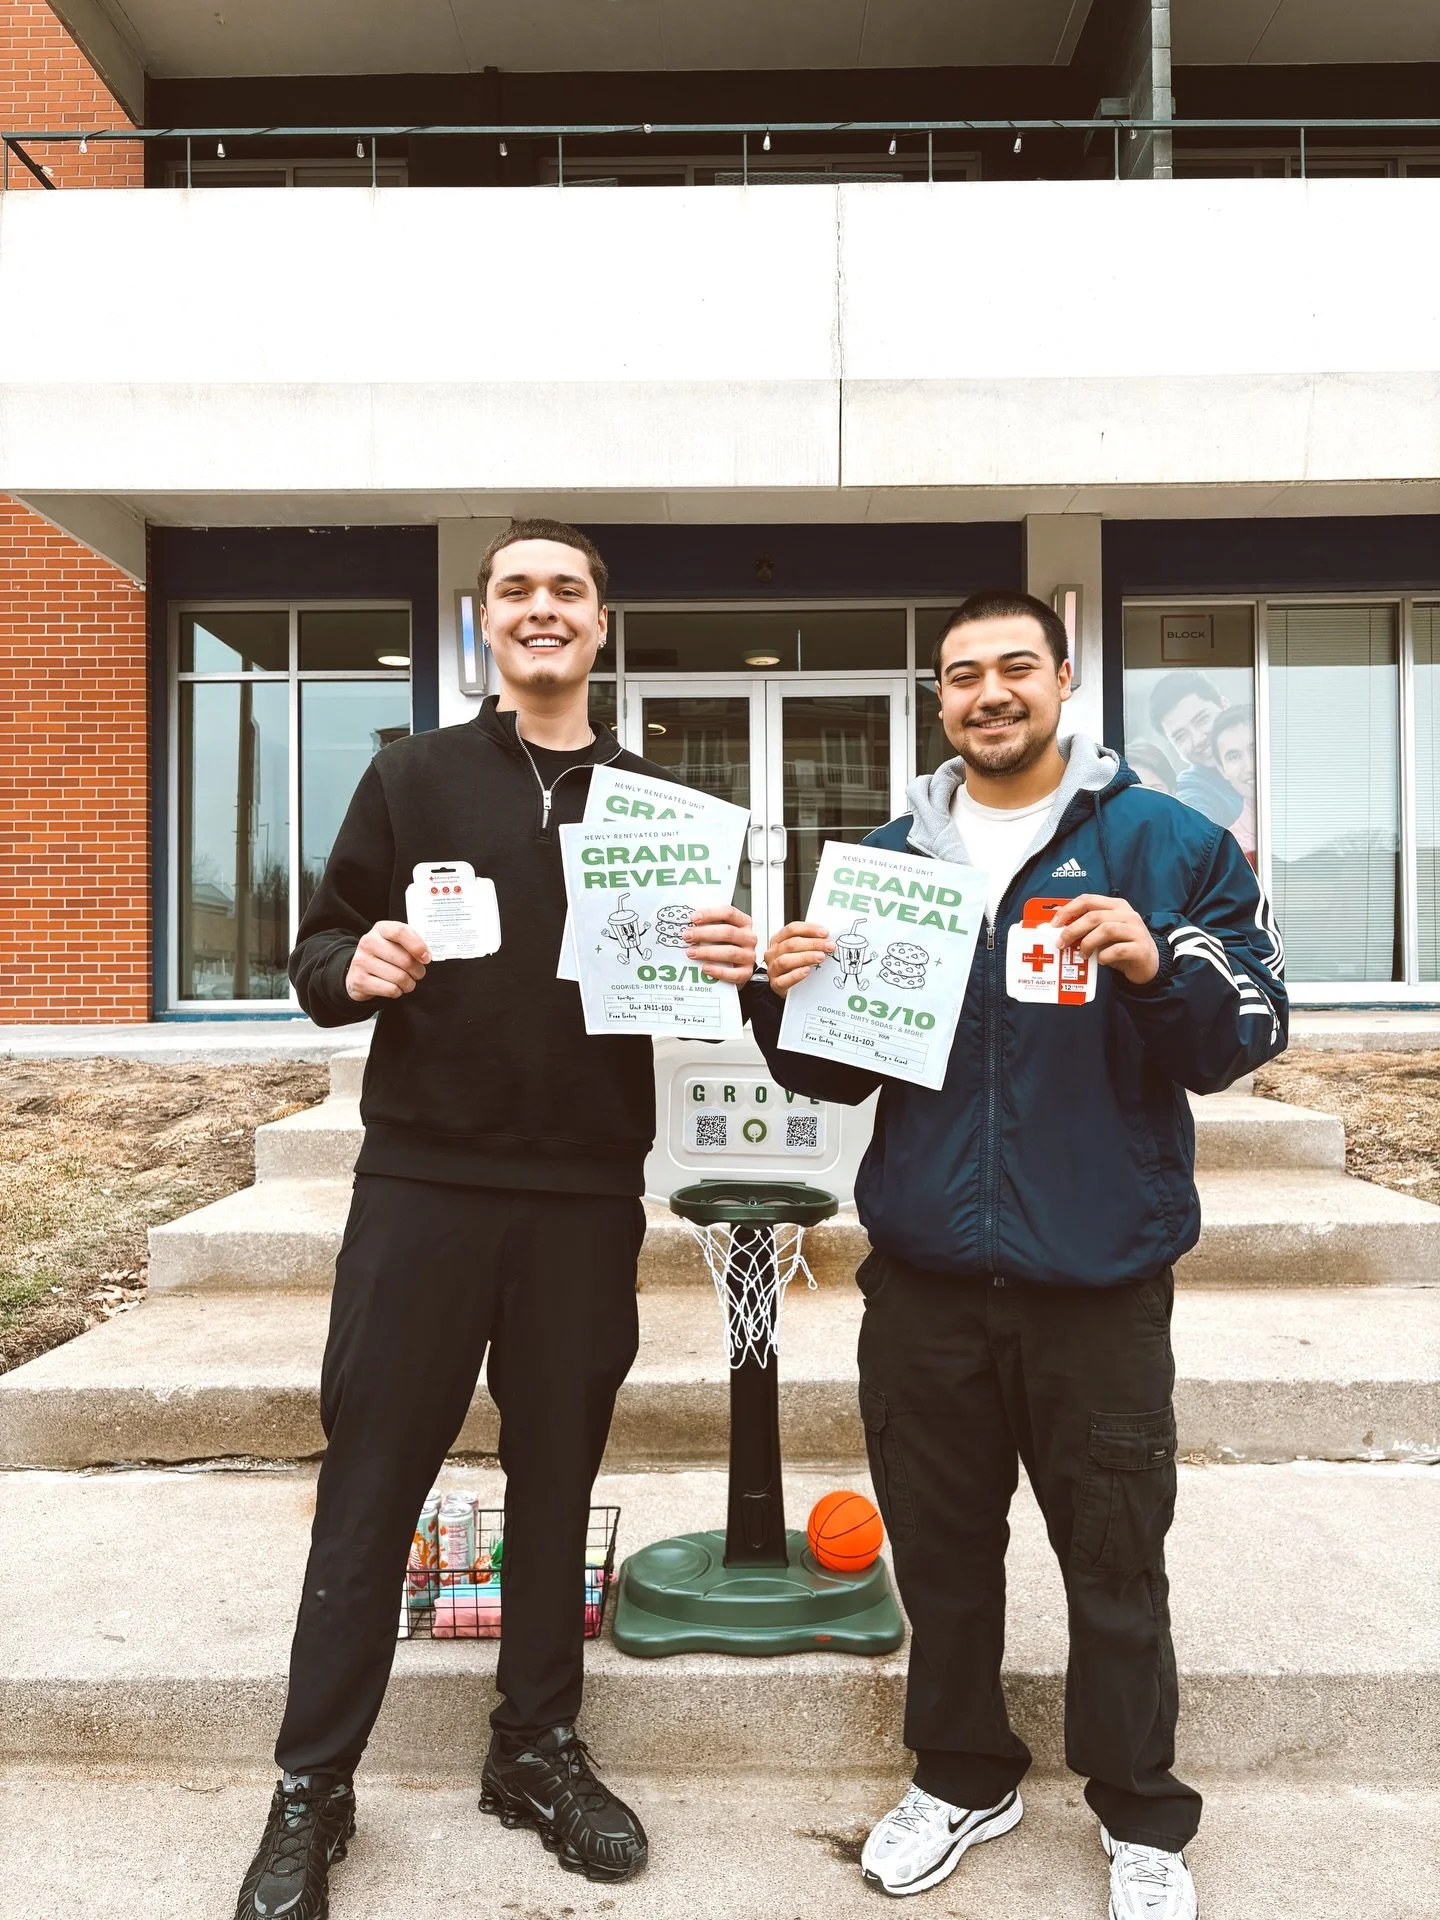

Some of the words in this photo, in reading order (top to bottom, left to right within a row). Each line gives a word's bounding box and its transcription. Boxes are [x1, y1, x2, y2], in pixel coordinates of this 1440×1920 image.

[1167, 631, 1206, 639] BLOCK
[614, 782, 641, 792] NEWLY
[644, 789, 687, 804] RENEVATED
[689, 801, 705, 810] UNIT
[606, 795, 694, 820] GRA
[613, 831, 658, 840] RENEVATED
[581, 843, 710, 866] GRAND
[842, 855, 866, 864] NEWLY
[869, 859, 913, 873] RENEVATED
[915, 868, 934, 877] UNIT
[1051, 869, 1087, 878] adidas
[583, 867, 722, 889] REVEAL
[833, 867, 963, 907] GRAND
[826, 889, 969, 936] REVEAL
[629, 1003, 641, 1011] Unit
[644, 1003, 673, 1012] 1411-103
[847, 994, 936, 1030] 03/10
[817, 1005, 846, 1018] COOKIES
[850, 1013, 869, 1024] DIRTY
[870, 1019, 893, 1030] SODAS
[904, 1028, 924, 1039] MORE
[804, 1033, 817, 1041] Free
[828, 1029, 842, 1038] Unit
[843, 1033, 875, 1047] 1411-103
